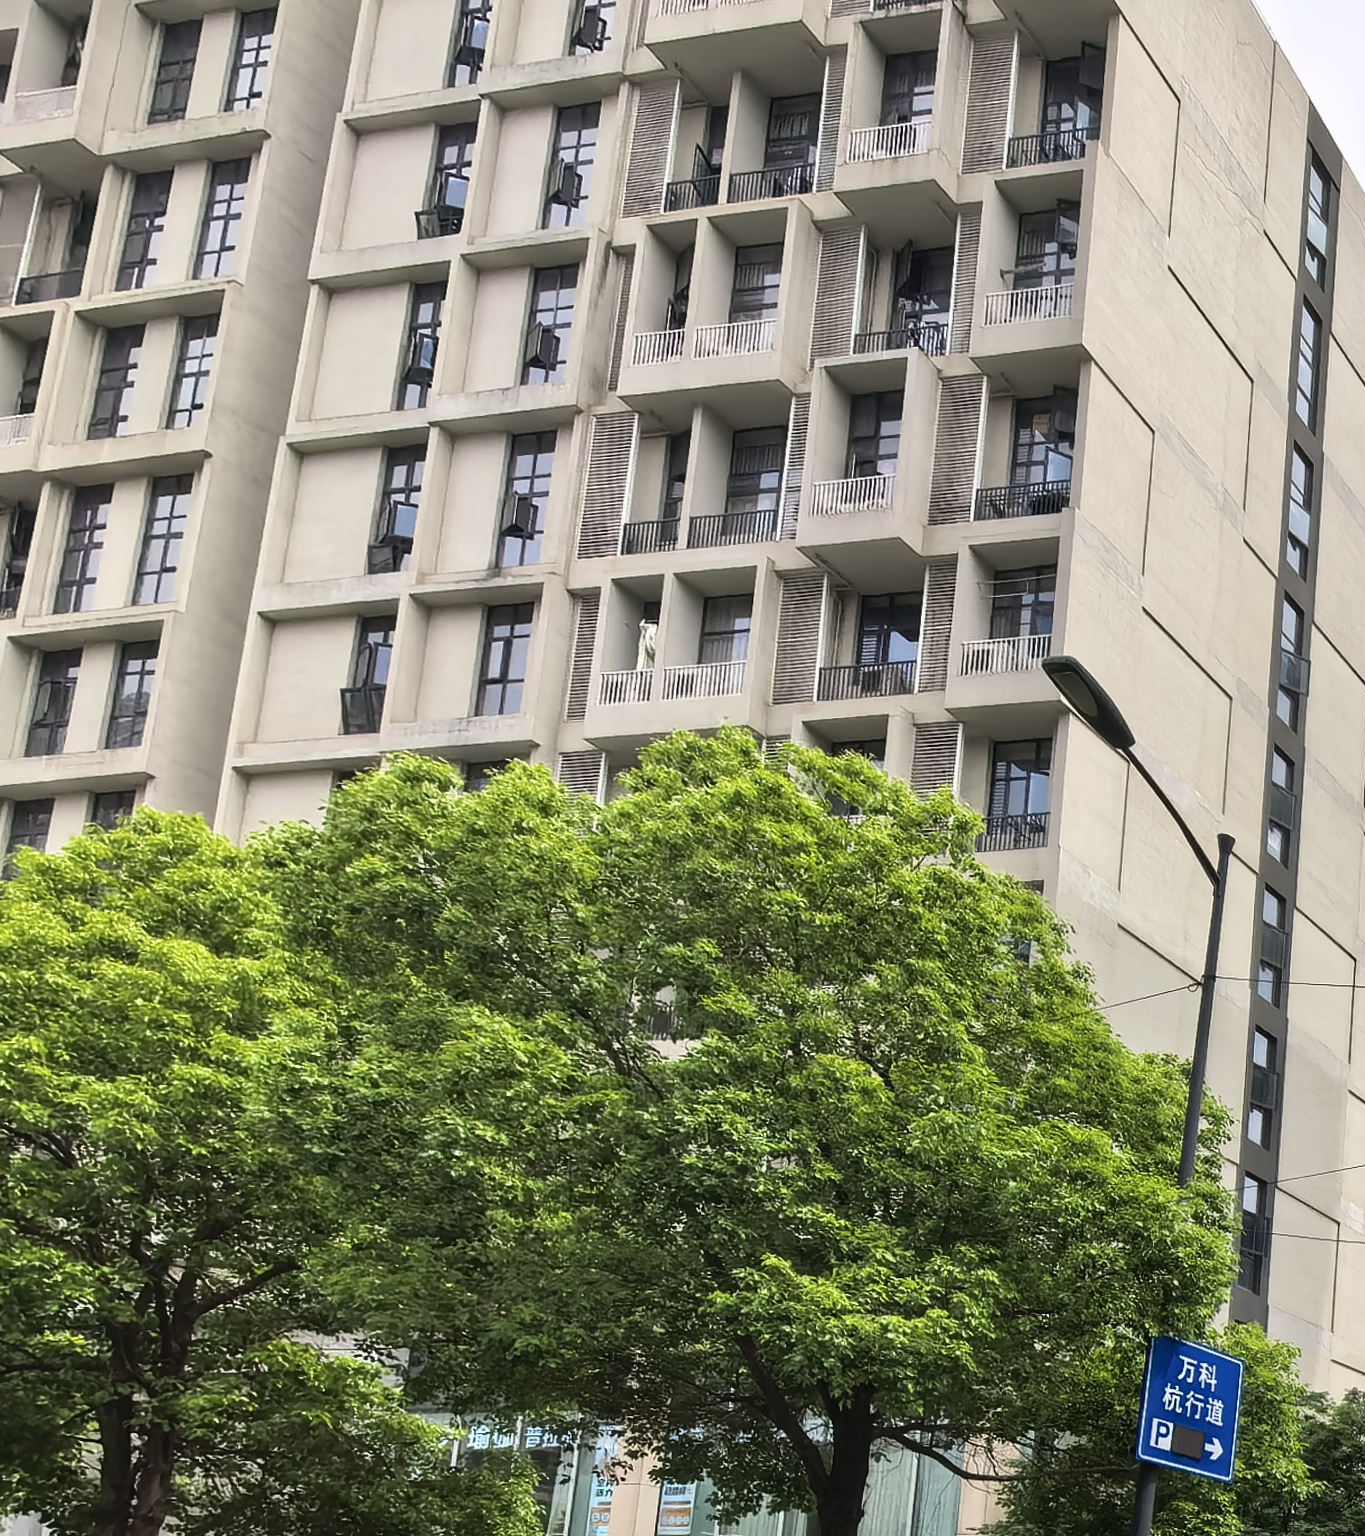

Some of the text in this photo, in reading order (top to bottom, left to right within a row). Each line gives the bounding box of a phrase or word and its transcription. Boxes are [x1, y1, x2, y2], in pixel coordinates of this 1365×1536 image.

[1177, 1355, 1218, 1392] 万科
[1162, 1383, 1224, 1426] 杭行道
